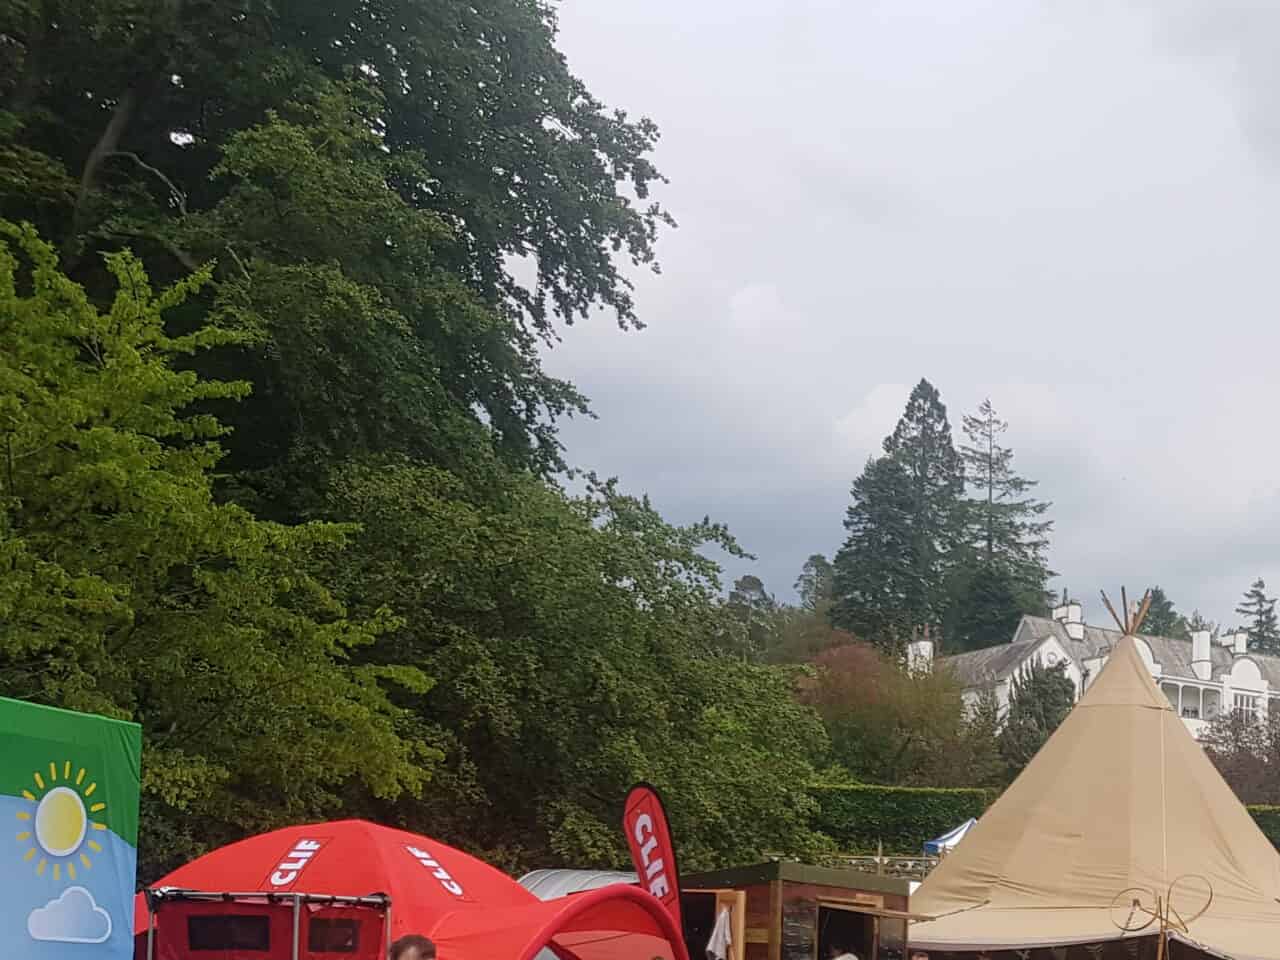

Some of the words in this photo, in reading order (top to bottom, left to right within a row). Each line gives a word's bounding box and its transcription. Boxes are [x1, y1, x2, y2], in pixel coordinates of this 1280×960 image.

[270, 839, 321, 886] CLIF
[405, 845, 464, 896] CLIF
[634, 813, 669, 898] CLIF
